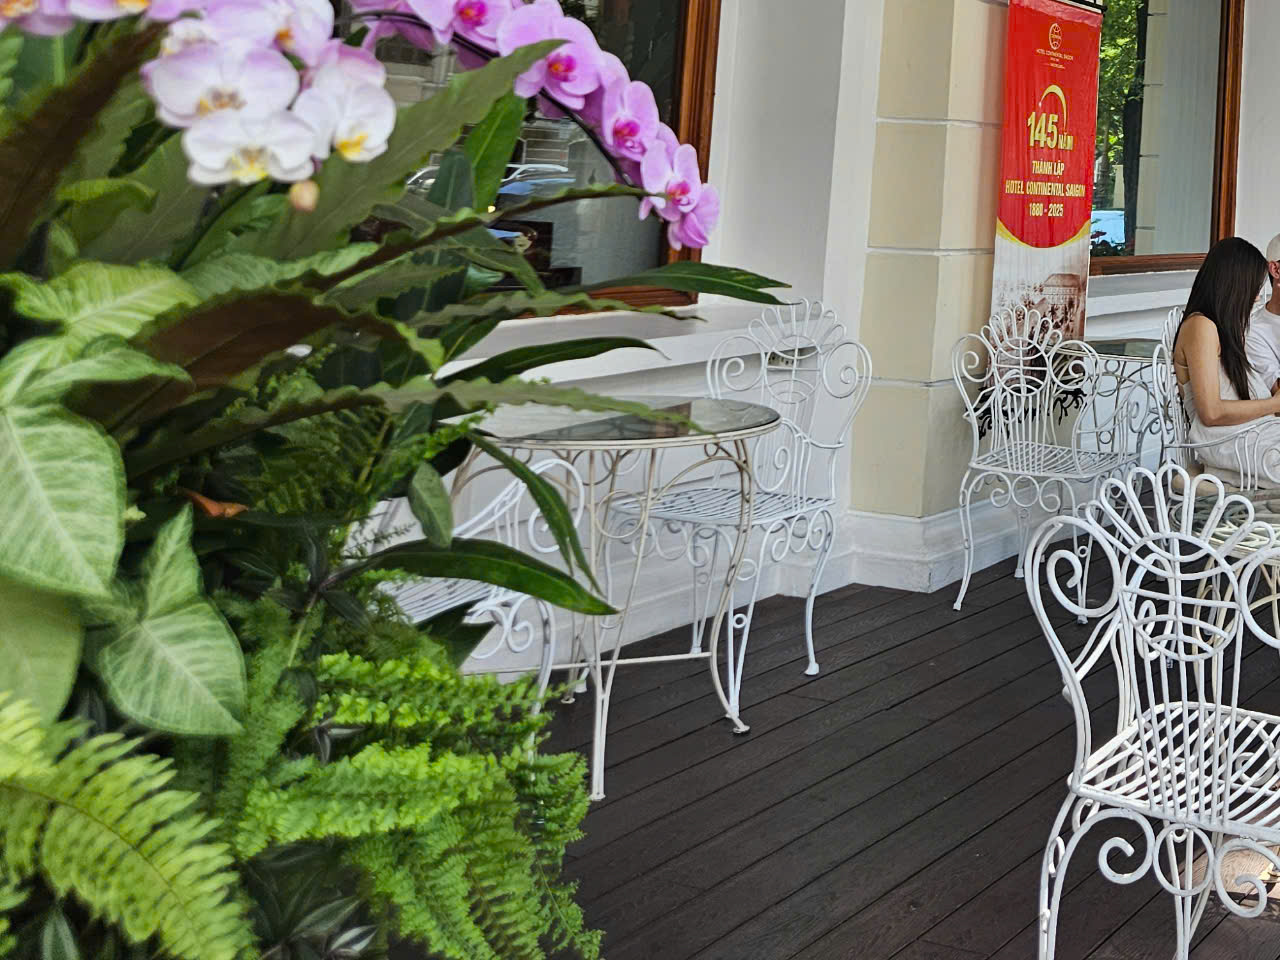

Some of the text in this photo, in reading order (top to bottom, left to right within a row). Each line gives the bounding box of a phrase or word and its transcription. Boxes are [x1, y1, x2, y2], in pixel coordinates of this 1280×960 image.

[1027, 111, 1059, 149] 145
[1005, 179, 1025, 195] HOTEL
[1026, 181, 1065, 197] CONTINENTAL
[1048, 203, 1064, 217] 2025
